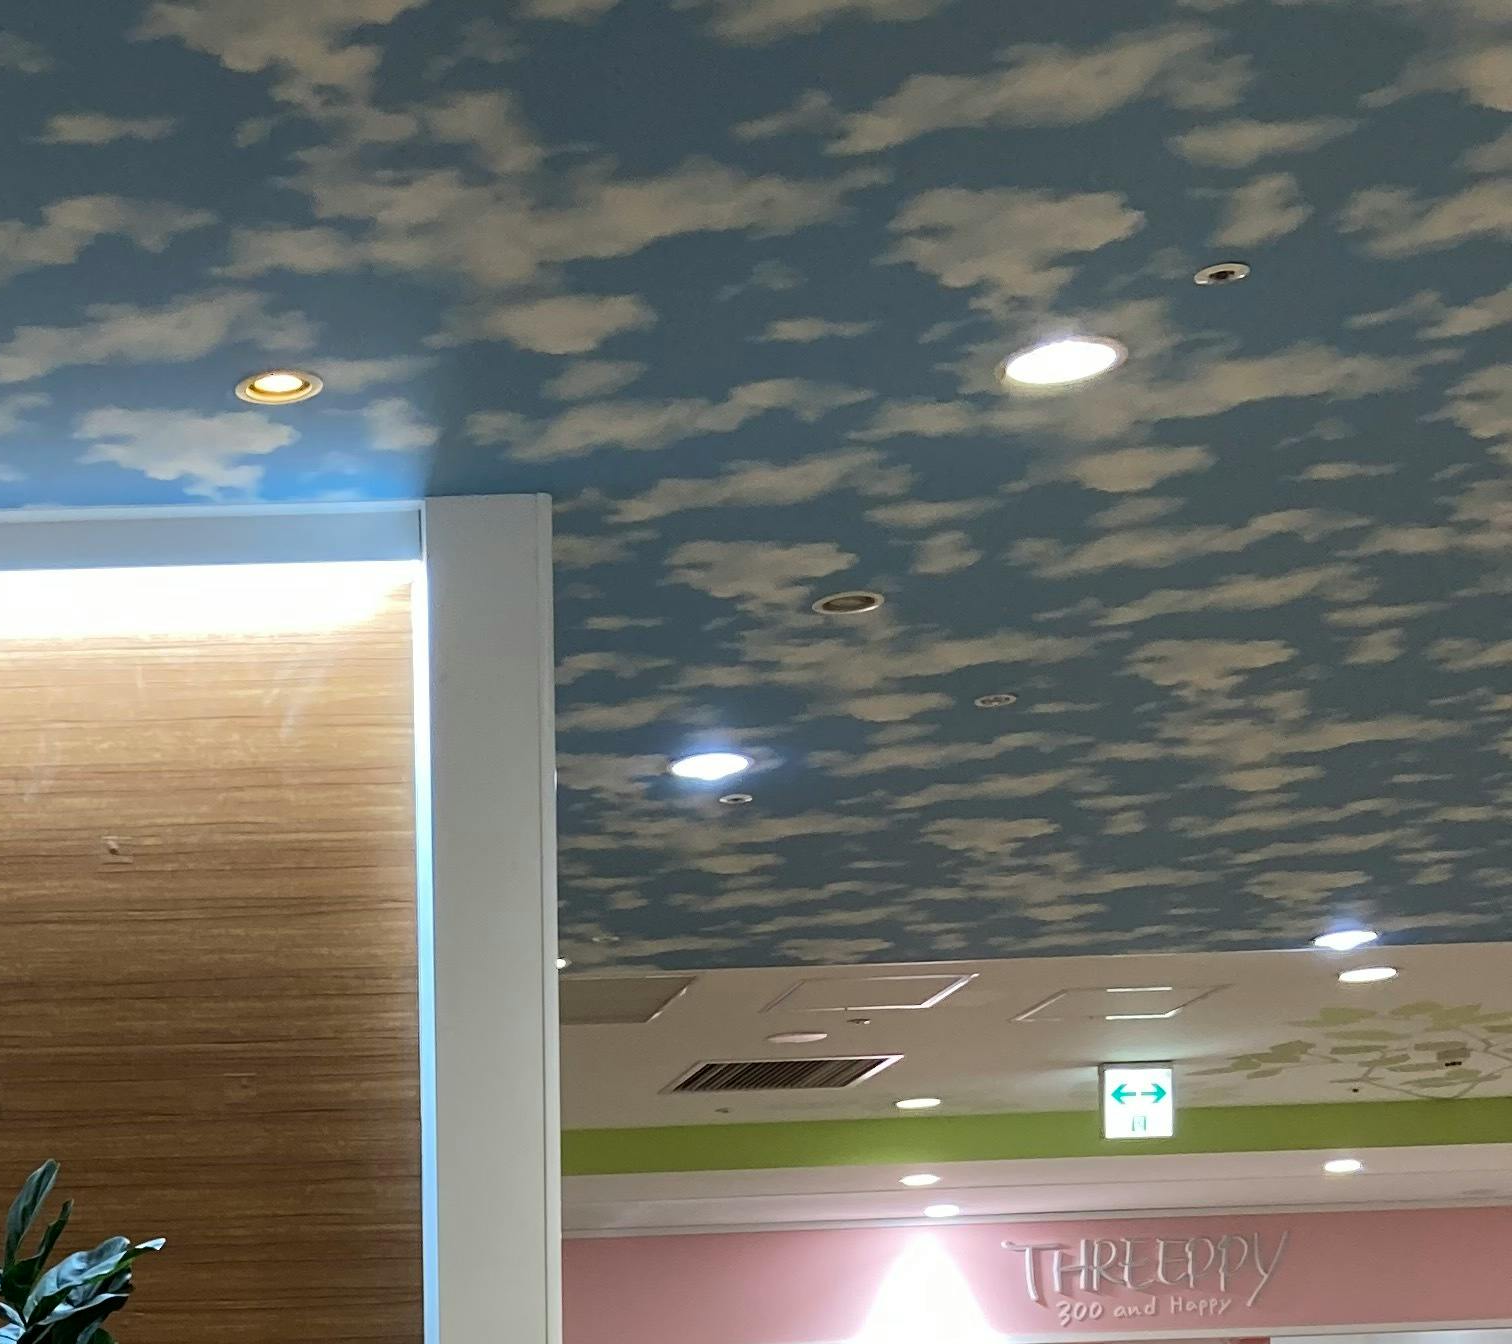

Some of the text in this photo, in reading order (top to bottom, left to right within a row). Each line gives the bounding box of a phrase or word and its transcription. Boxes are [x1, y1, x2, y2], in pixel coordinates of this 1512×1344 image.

[1001, 1231, 1288, 1307] THREEPPY
[1055, 1296, 1233, 1327] 300 and Happy
